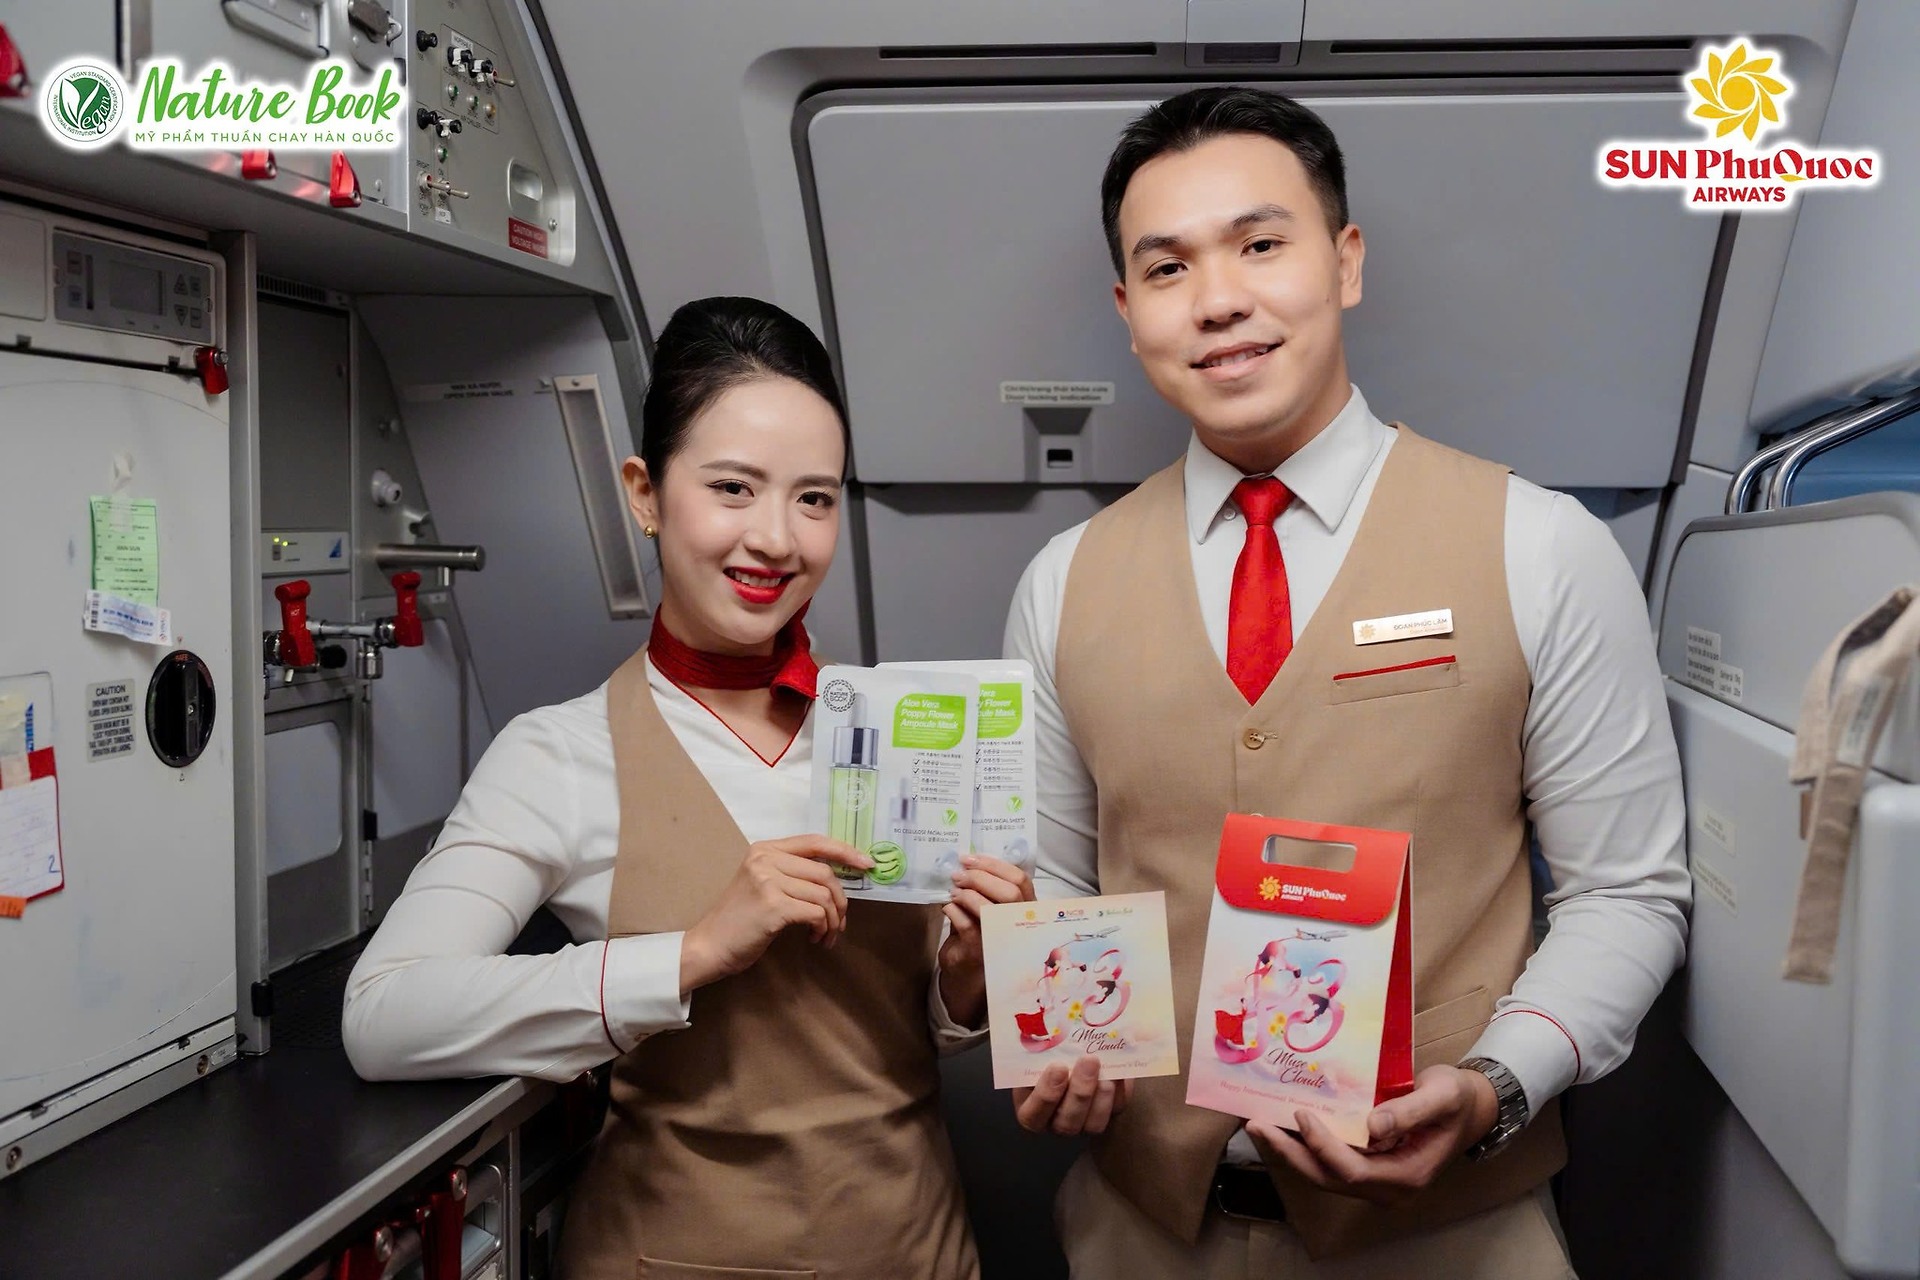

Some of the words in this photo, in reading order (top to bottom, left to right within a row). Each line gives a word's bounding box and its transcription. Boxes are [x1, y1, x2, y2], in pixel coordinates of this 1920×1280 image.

[96, 685, 126, 696] CAUTION
[900, 708, 927, 719] Poppy
[1282, 884, 1302, 895] SUN
[1302, 886, 1347, 901] PhuQuoc
[1071, 1028, 1108, 1042] Muse
[1086, 1038, 1126, 1054] Clouds
[1268, 1048, 1308, 1068] Muse
[1280, 1067, 1324, 1088] Clouds
